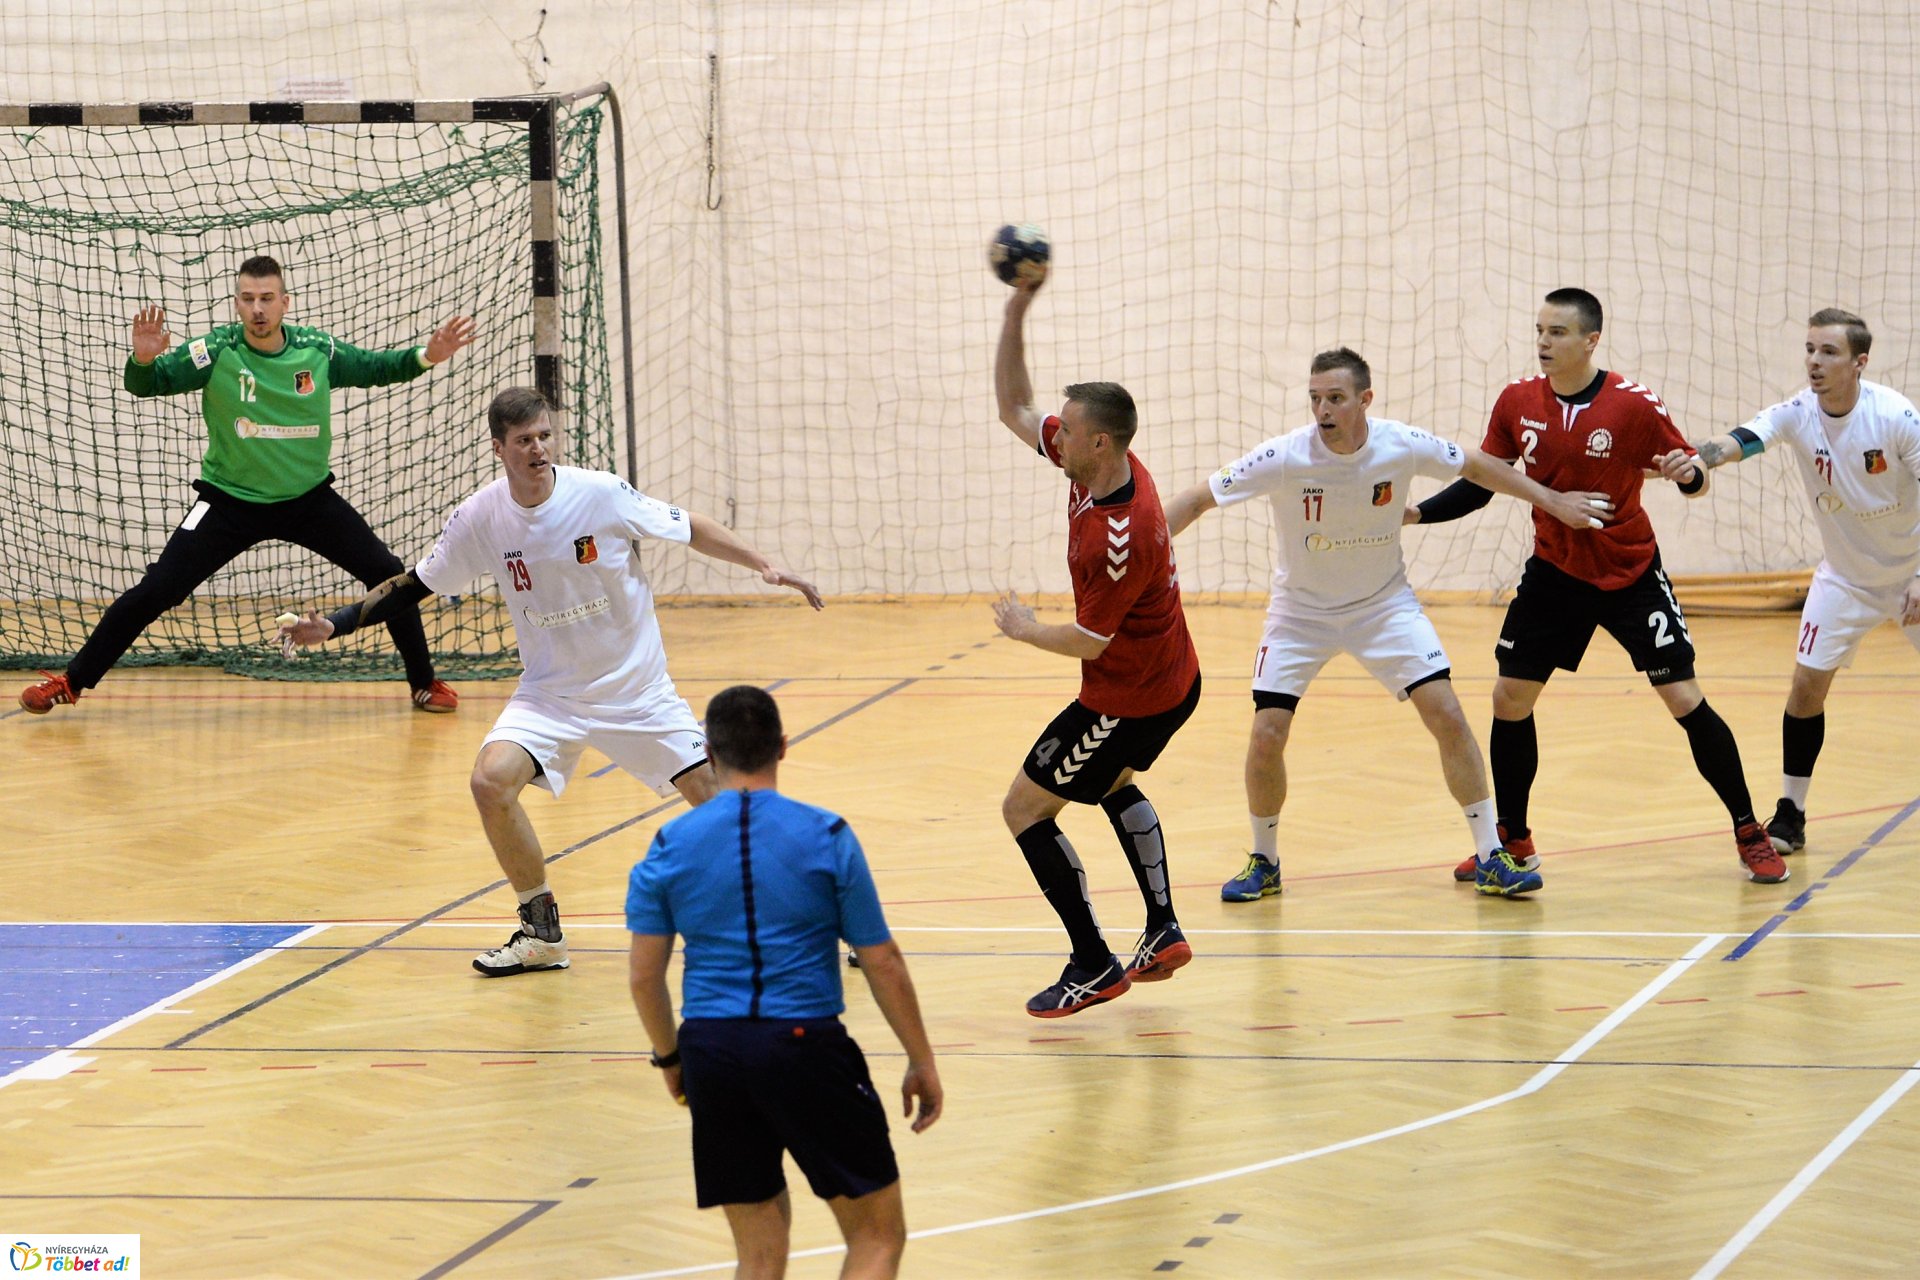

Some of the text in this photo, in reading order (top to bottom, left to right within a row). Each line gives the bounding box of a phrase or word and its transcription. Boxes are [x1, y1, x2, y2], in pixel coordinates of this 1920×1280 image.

[239, 375, 256, 402] 12
[1520, 416, 1547, 431] hummel
[1521, 430, 1538, 465] 2
[1302, 495, 1323, 521] 17
[503, 550, 522, 560] JAKO
[507, 559, 532, 592] 29
[1648, 611, 1675, 648] 2
[1799, 622, 1819, 655] 21
[1036, 737, 1061, 768] 4
